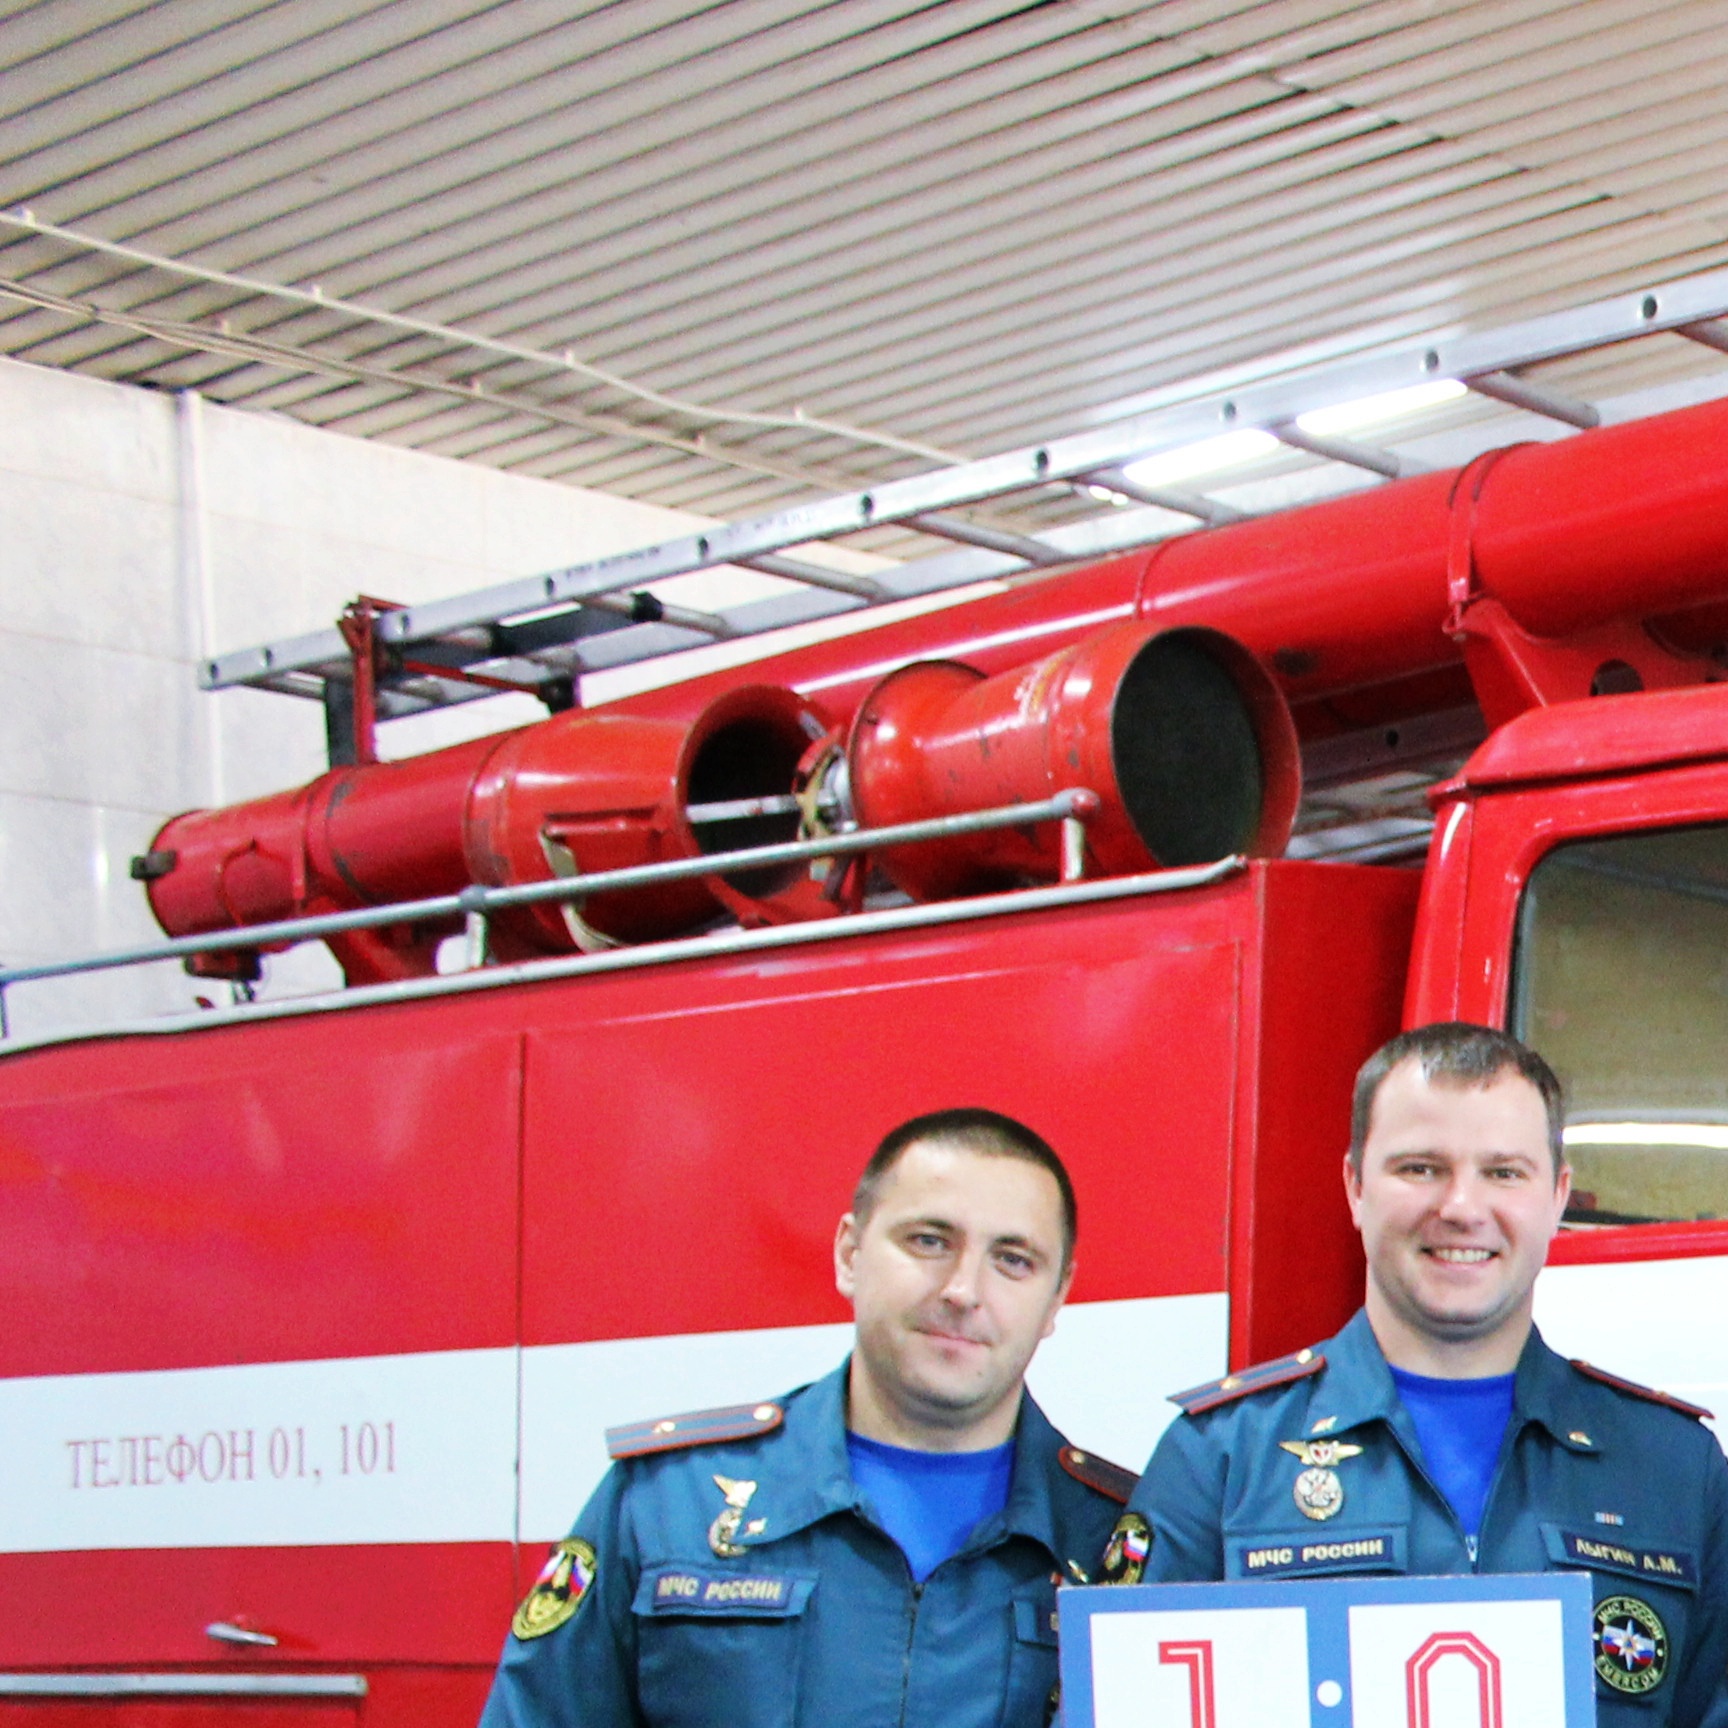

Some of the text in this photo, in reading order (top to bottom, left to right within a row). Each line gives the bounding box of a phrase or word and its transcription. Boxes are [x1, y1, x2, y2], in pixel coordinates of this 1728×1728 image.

[66, 1429, 254, 1489] ТЕЛЕФОН
[339, 1420, 397, 1475] 101
[1248, 1538, 1384, 1569] МЧС РОССИИ
[656, 1575, 782, 1602] МЧС РОССИИ
